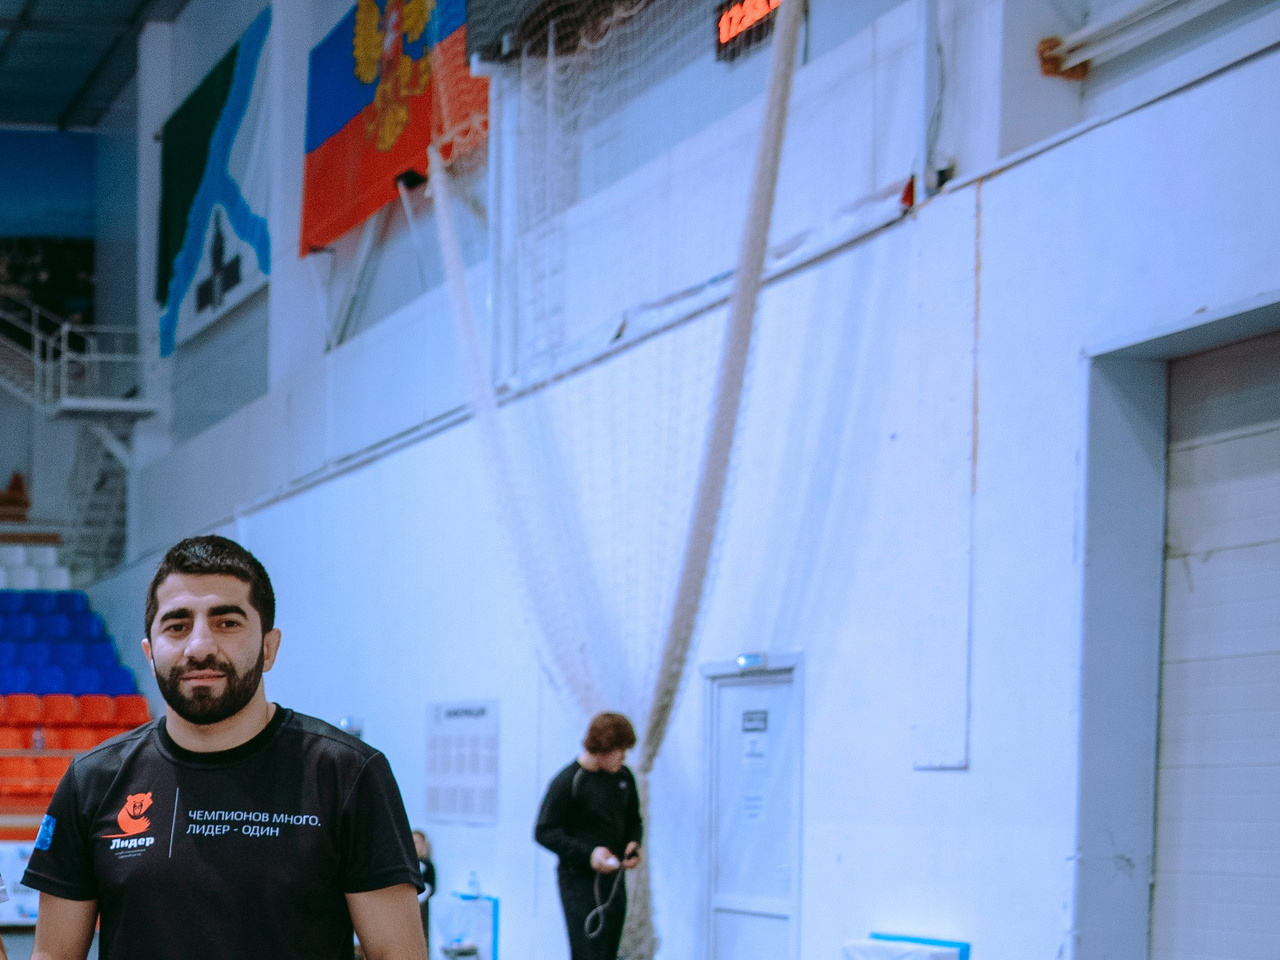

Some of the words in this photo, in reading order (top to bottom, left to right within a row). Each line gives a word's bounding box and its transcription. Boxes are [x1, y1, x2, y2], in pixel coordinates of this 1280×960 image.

[188, 810, 270, 823] ЧЕМПИОНОВ
[272, 813, 322, 827] МНОГО.
[186, 823, 231, 837] ЛИДЕР
[241, 824, 280, 837] ОДИН
[109, 836, 155, 850] Лидер
